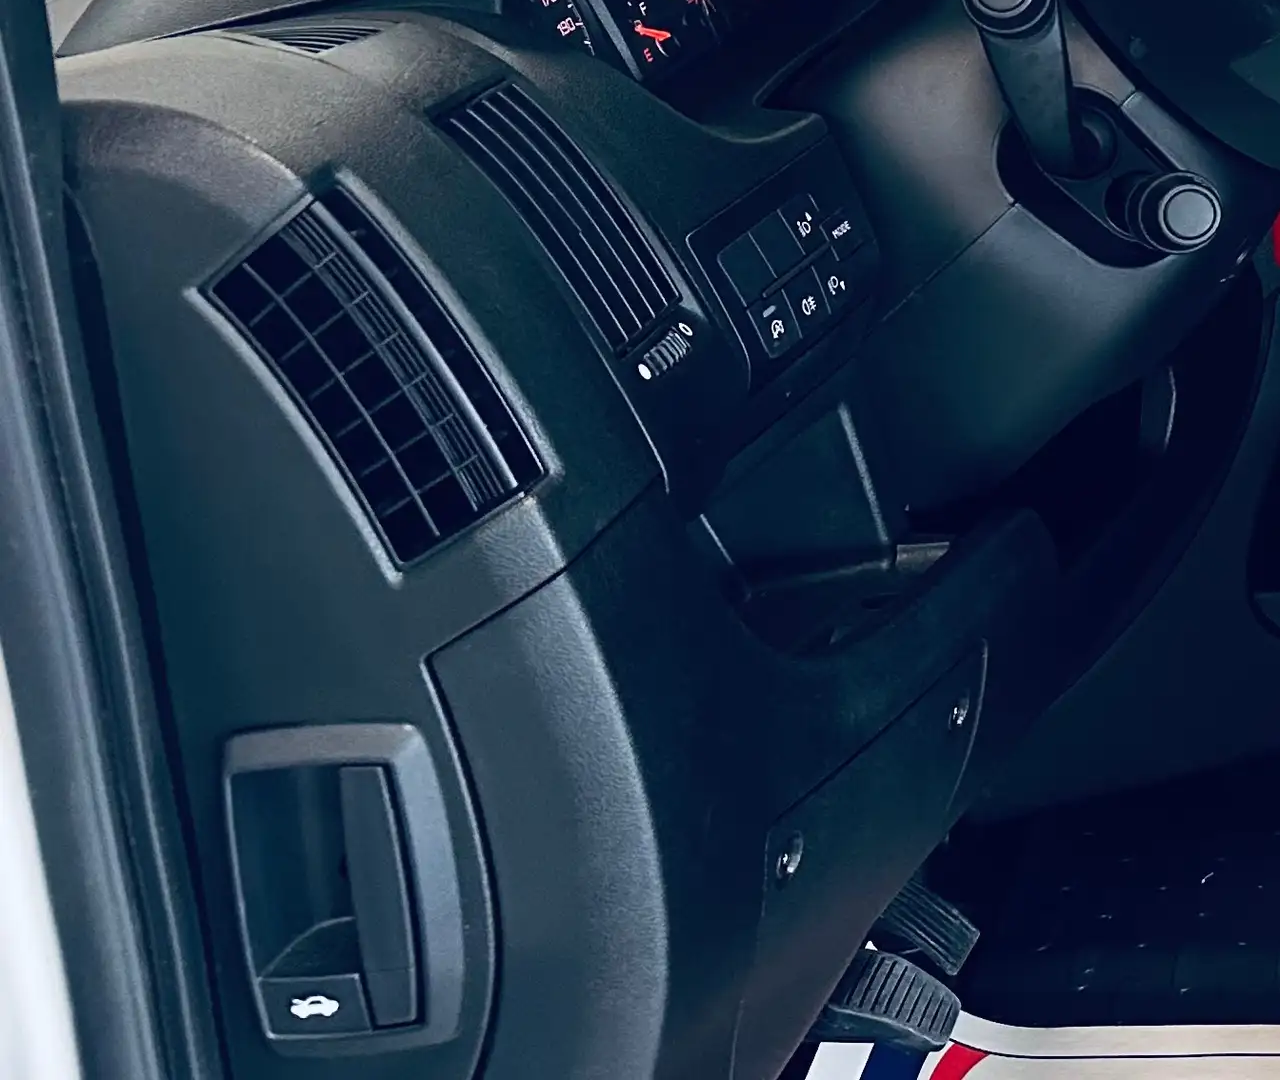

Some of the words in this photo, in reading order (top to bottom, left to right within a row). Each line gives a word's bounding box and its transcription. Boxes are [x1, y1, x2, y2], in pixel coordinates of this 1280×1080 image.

[639, 1, 647, 16] F
[643, 48, 654, 62] E
[831, 220, 851, 240] MODE
